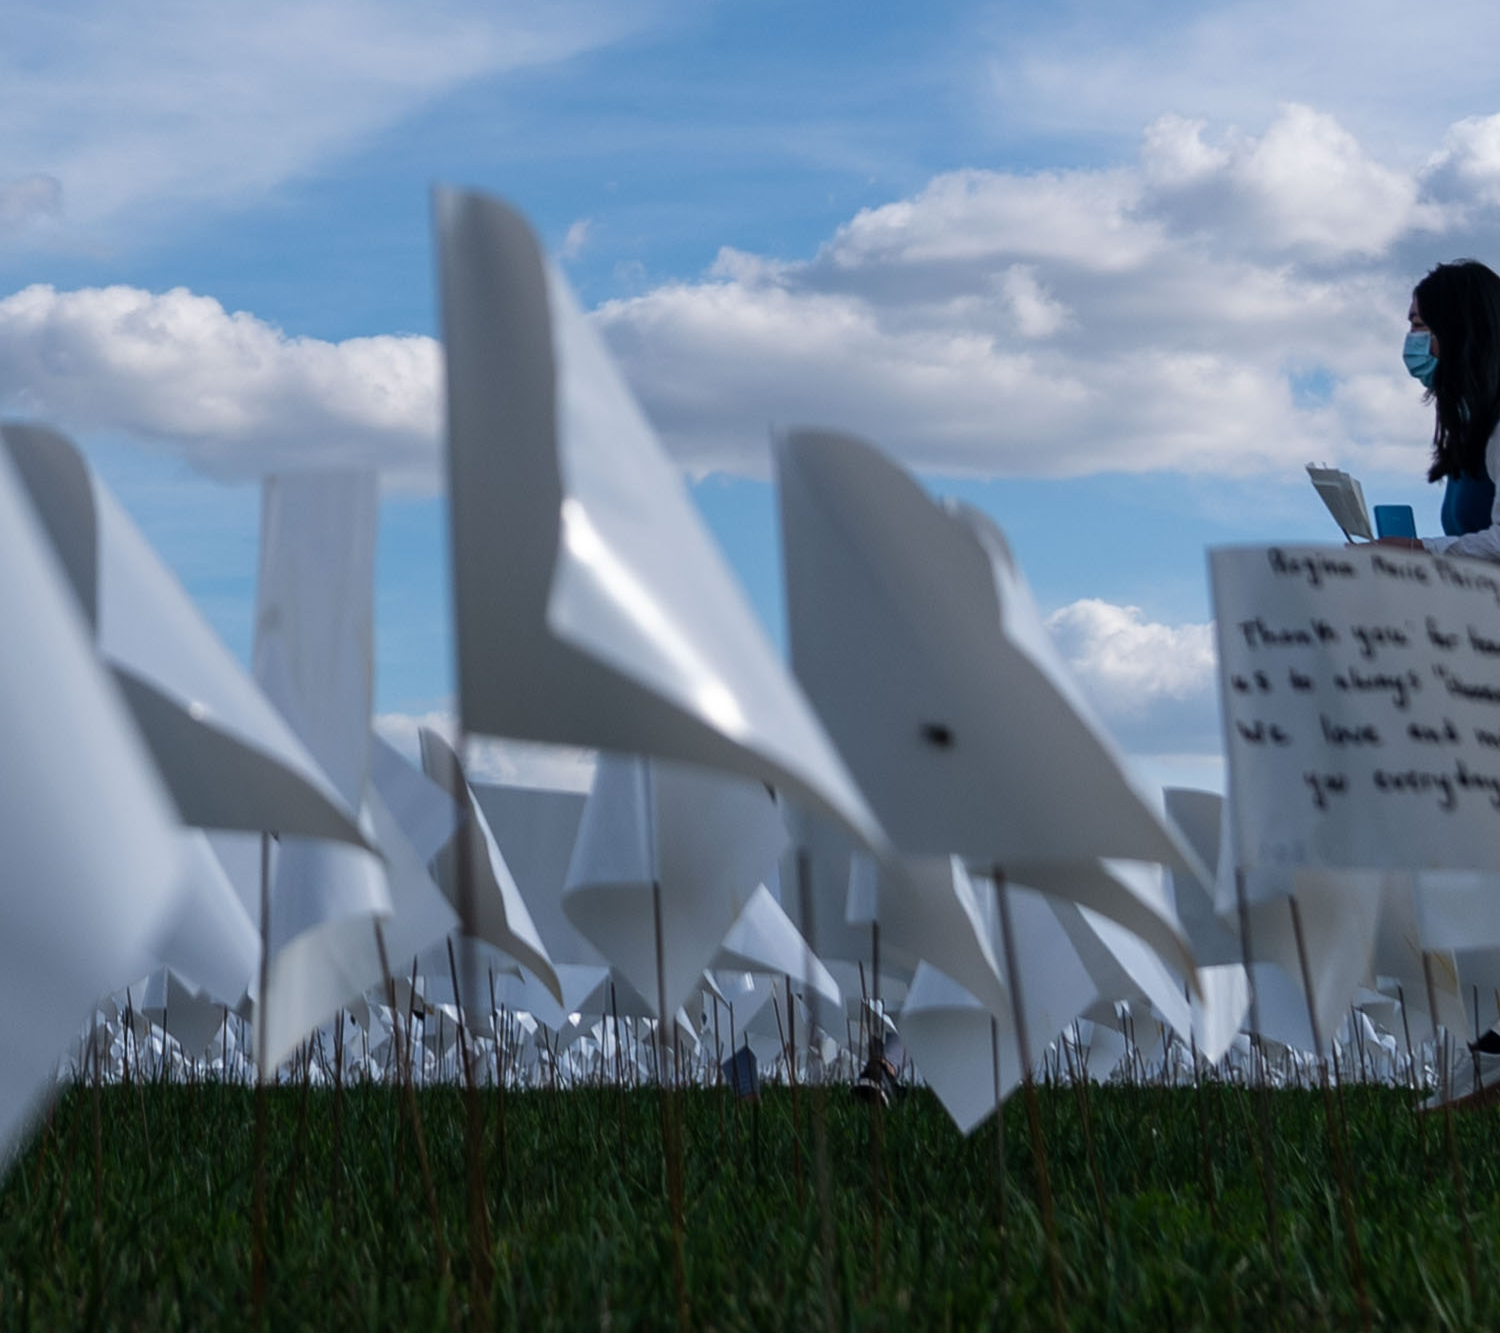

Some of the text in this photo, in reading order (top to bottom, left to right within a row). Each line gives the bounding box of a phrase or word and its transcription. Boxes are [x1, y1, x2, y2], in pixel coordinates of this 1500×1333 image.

[1239, 616, 1338, 650] Thank
[1351, 623, 1408, 660] you
[1231, 671, 1272, 695] us
[1333, 666, 1421, 712] always
[1319, 713, 1384, 748] love
[1407, 717, 1459, 747] and
[1303, 769, 1349, 811] you
